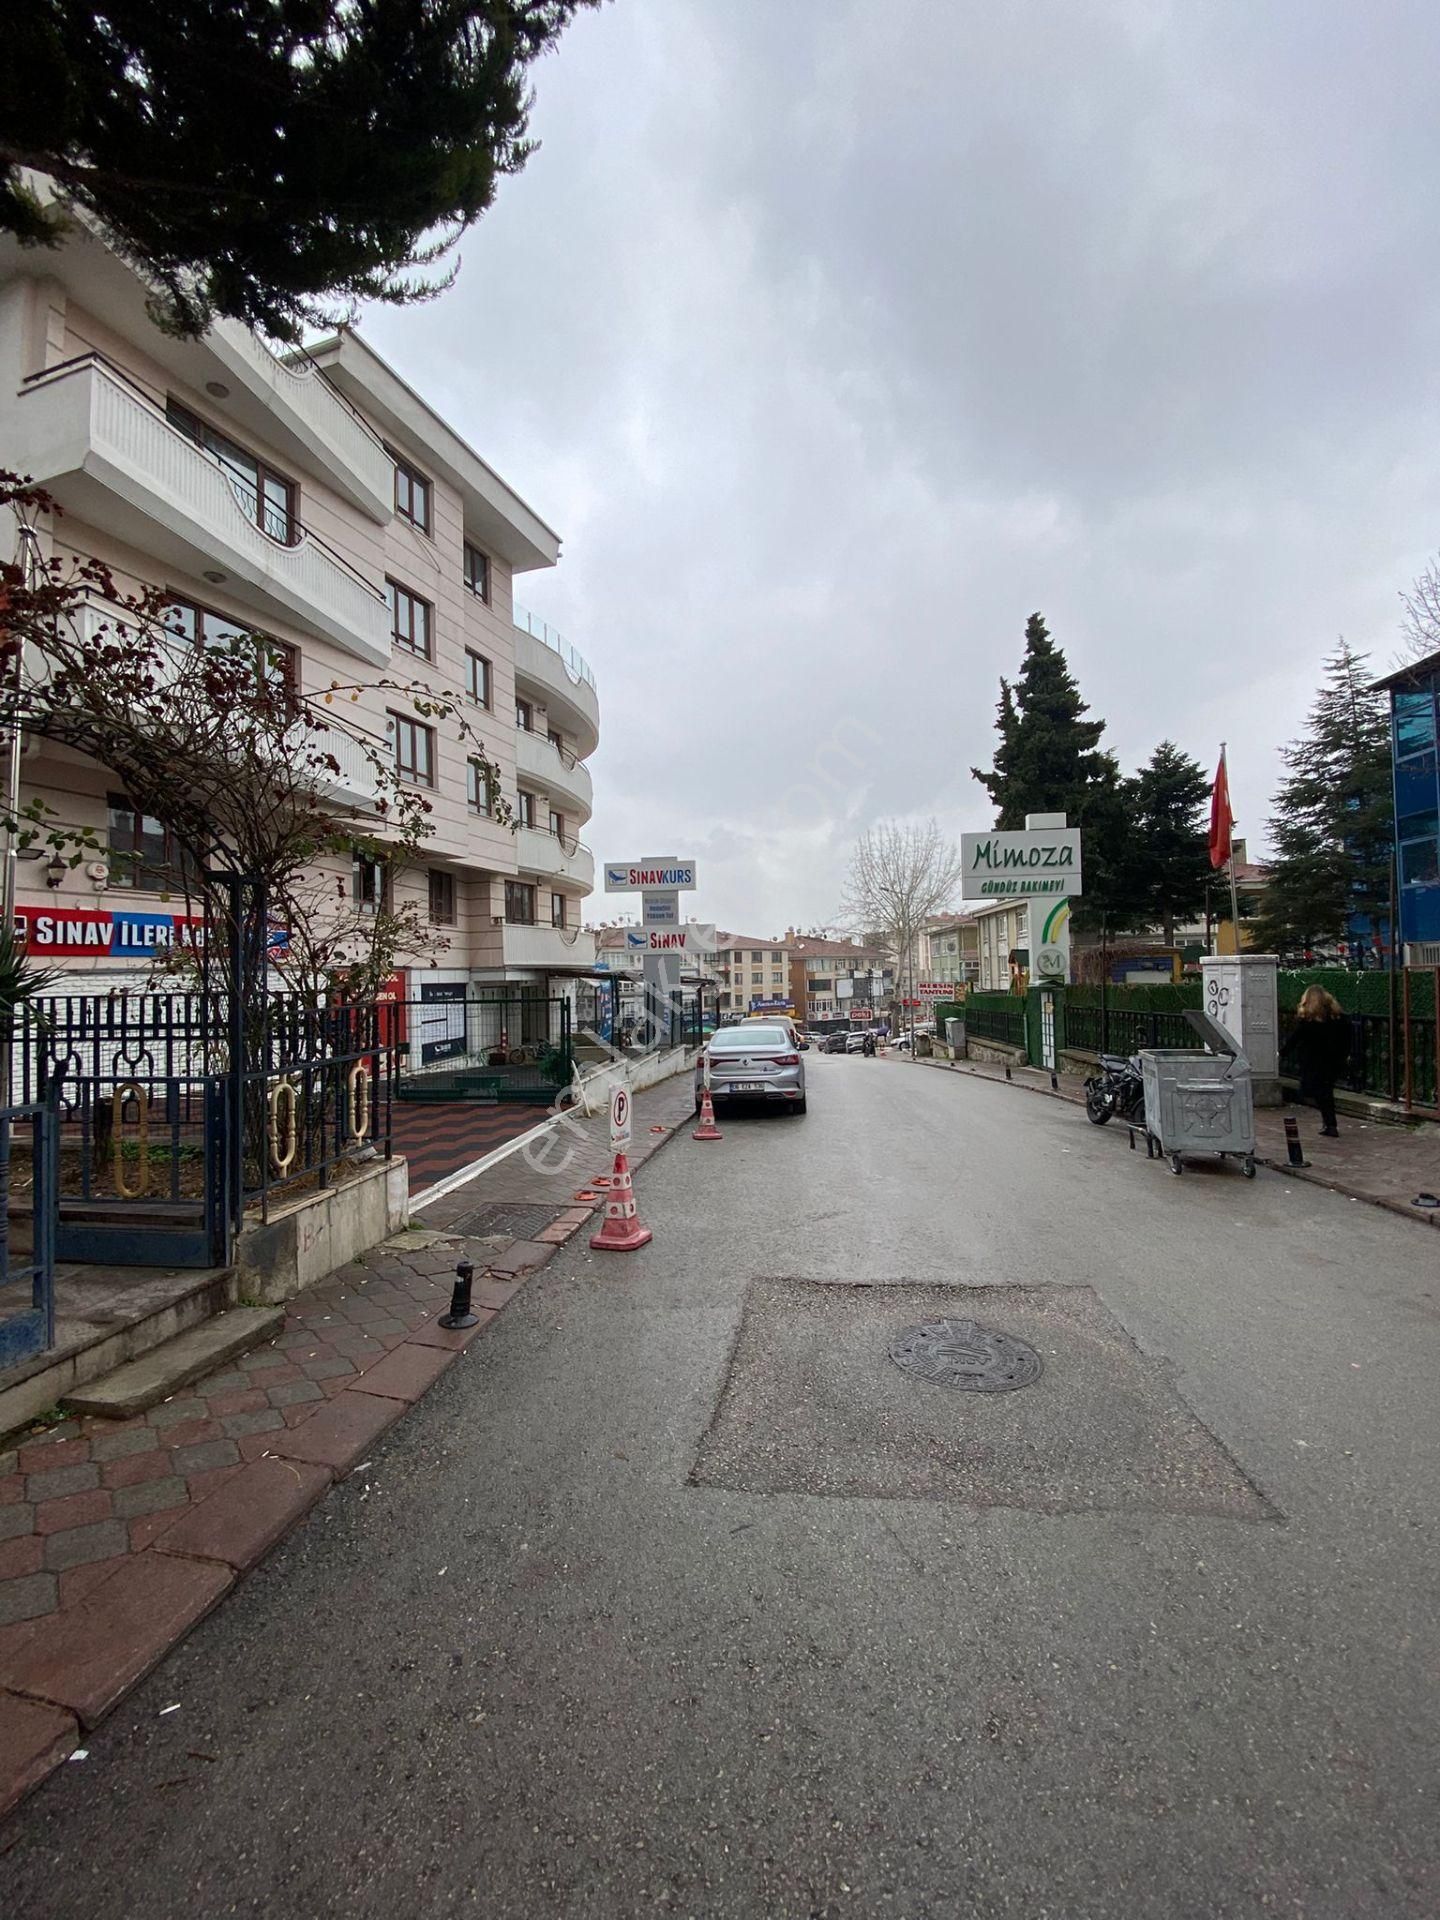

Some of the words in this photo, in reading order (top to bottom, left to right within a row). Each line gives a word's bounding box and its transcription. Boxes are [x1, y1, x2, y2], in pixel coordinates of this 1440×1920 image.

[972, 840, 1073, 870] Mimoza
[981, 880, 1017, 894] GÜNDÜZ
[36, 916, 114, 945] SINAV
[650, 932, 686, 949] SINAV
